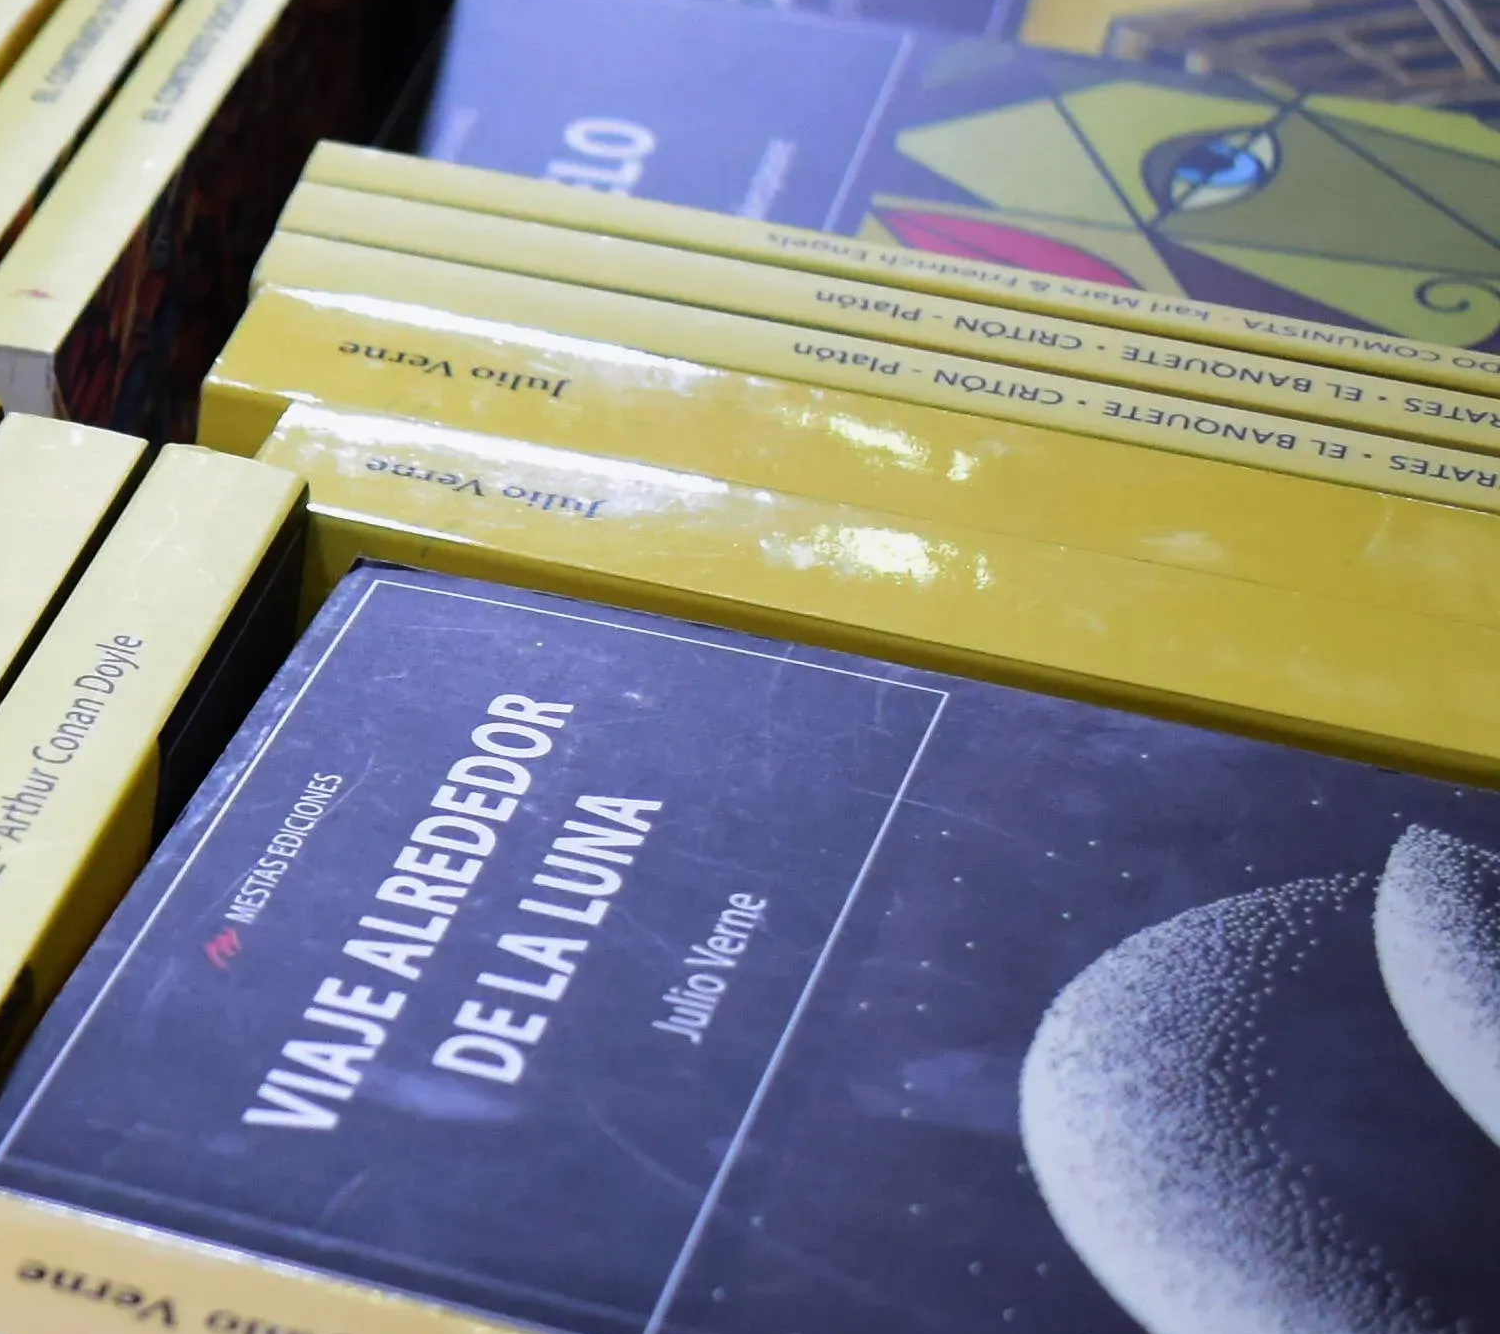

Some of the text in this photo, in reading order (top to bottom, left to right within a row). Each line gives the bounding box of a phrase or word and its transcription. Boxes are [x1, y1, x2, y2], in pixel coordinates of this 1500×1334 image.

[815, 289, 921, 321] Platón
[953, 315, 1082, 350] CRITÓN
[337, 342, 569, 398] Julio Verne
[792, 341, 900, 375] Platón
[1121, 345, 1312, 393] BANQUETE
[932, 368, 1064, 405] CRITÓN
[1326, 382, 1363, 402] EL
[1101, 400, 1297, 450] BANQUETE
[1310, 439, 1348, 459] EL
[223, 771, 343, 923] MESTAS EDICIONES
[242, 693, 574, 1130] VIAJE ALREDEDOR
[431, 794, 663, 1083] DE LA LUNA
[651, 892, 767, 1044] Julio Verne
[17, 1264, 177, 1328] Verne
